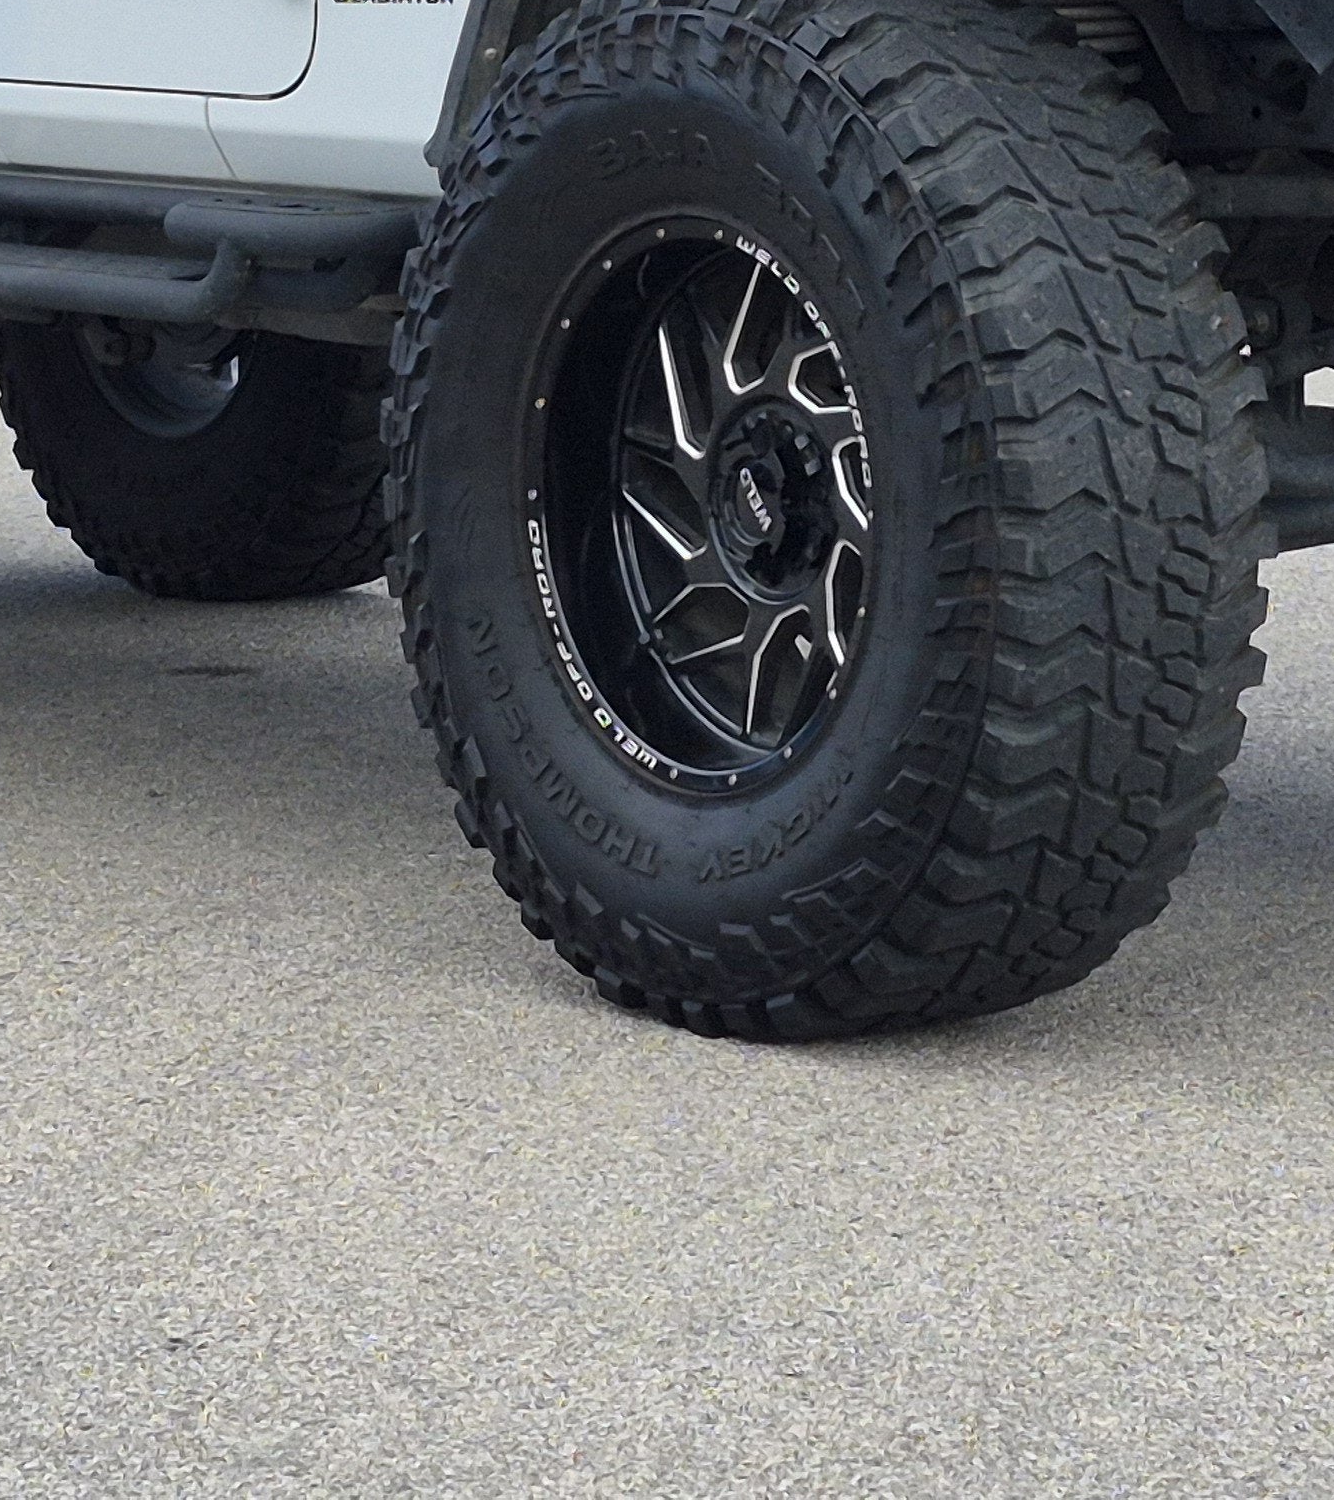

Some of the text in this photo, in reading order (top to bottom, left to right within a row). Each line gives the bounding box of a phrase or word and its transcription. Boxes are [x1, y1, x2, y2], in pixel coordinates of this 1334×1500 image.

[735, 234, 801, 296] WELD
[739, 467, 773, 533] WELD
[526, 519, 659, 771] WELD OFF-ROAD
